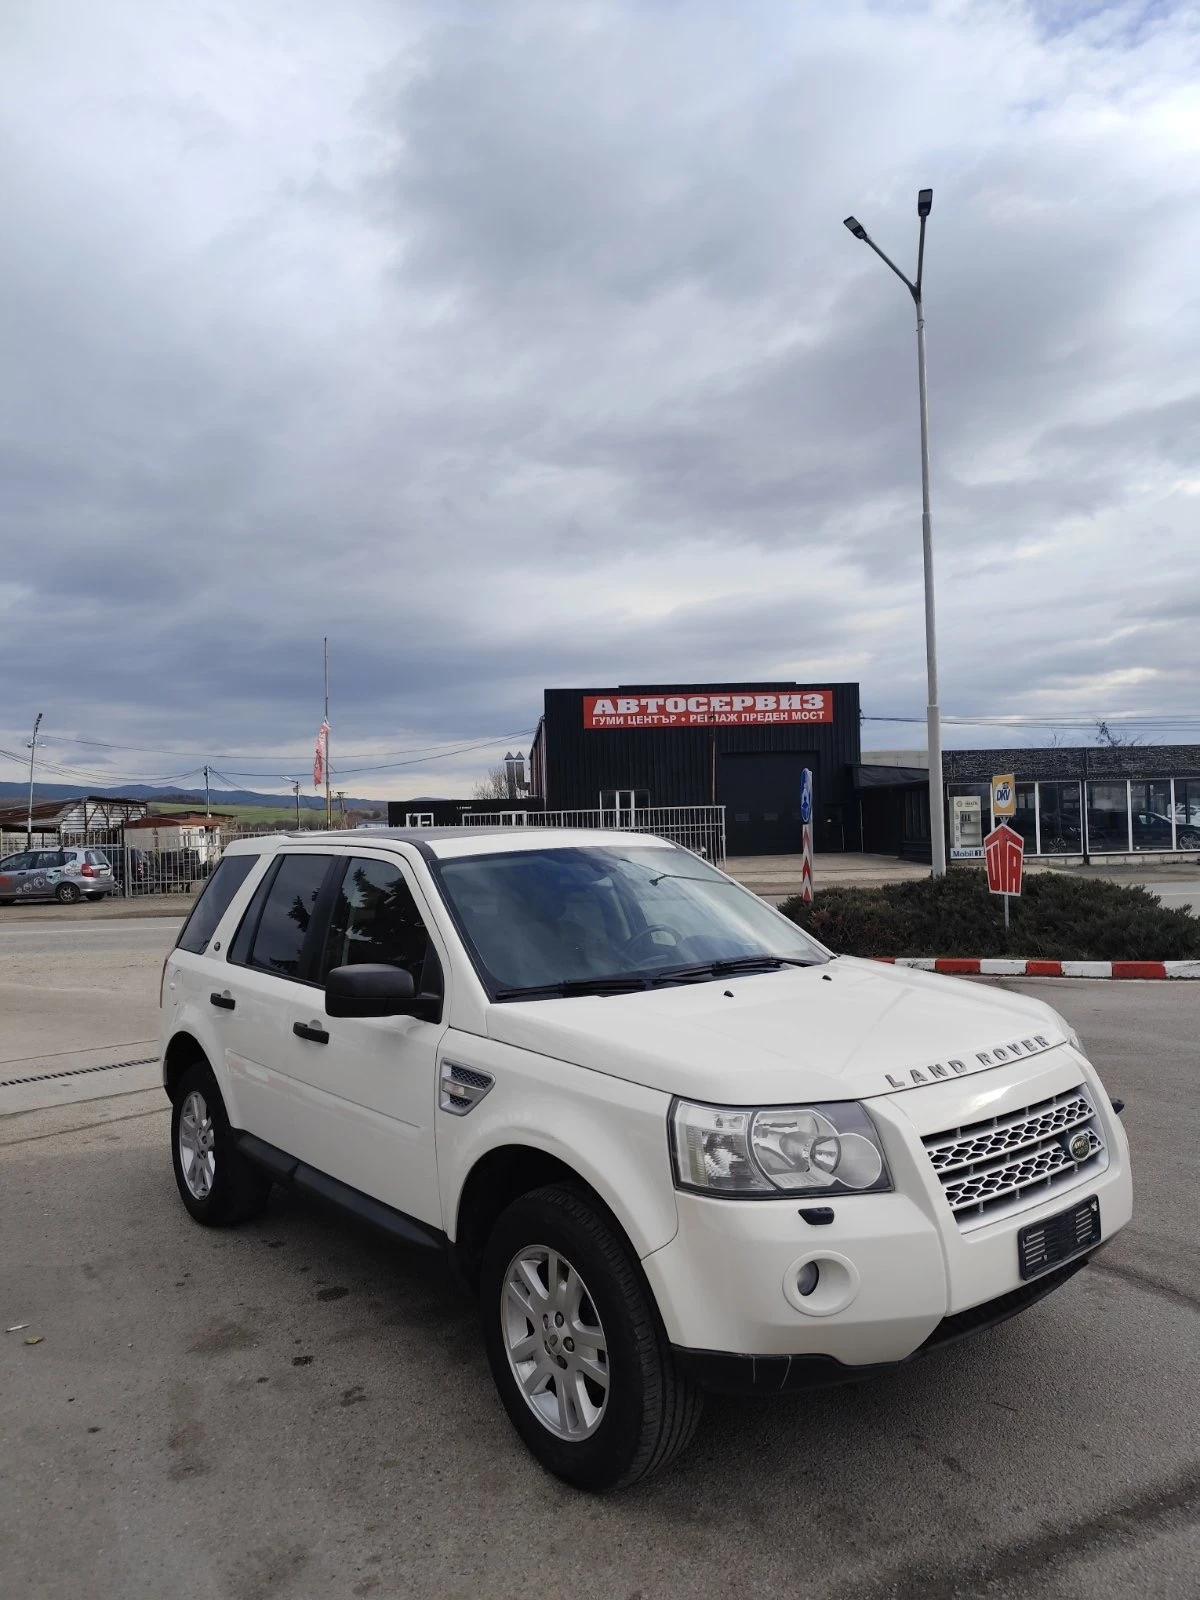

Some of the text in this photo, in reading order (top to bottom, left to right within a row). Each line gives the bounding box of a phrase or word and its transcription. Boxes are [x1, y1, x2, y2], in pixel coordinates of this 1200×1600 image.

[592, 693, 824, 714] АВТОСЕРВИЗ
[592, 716, 624, 726] ГУМИ
[627, 715, 677, 726] ЦЕНТЪР
[741, 712, 789, 723] ПРЕДЕН
[792, 711, 824, 721] МОСТ
[996, 789, 1011, 801] DKV
[885, 1035, 1050, 1088] LAND ROVER
